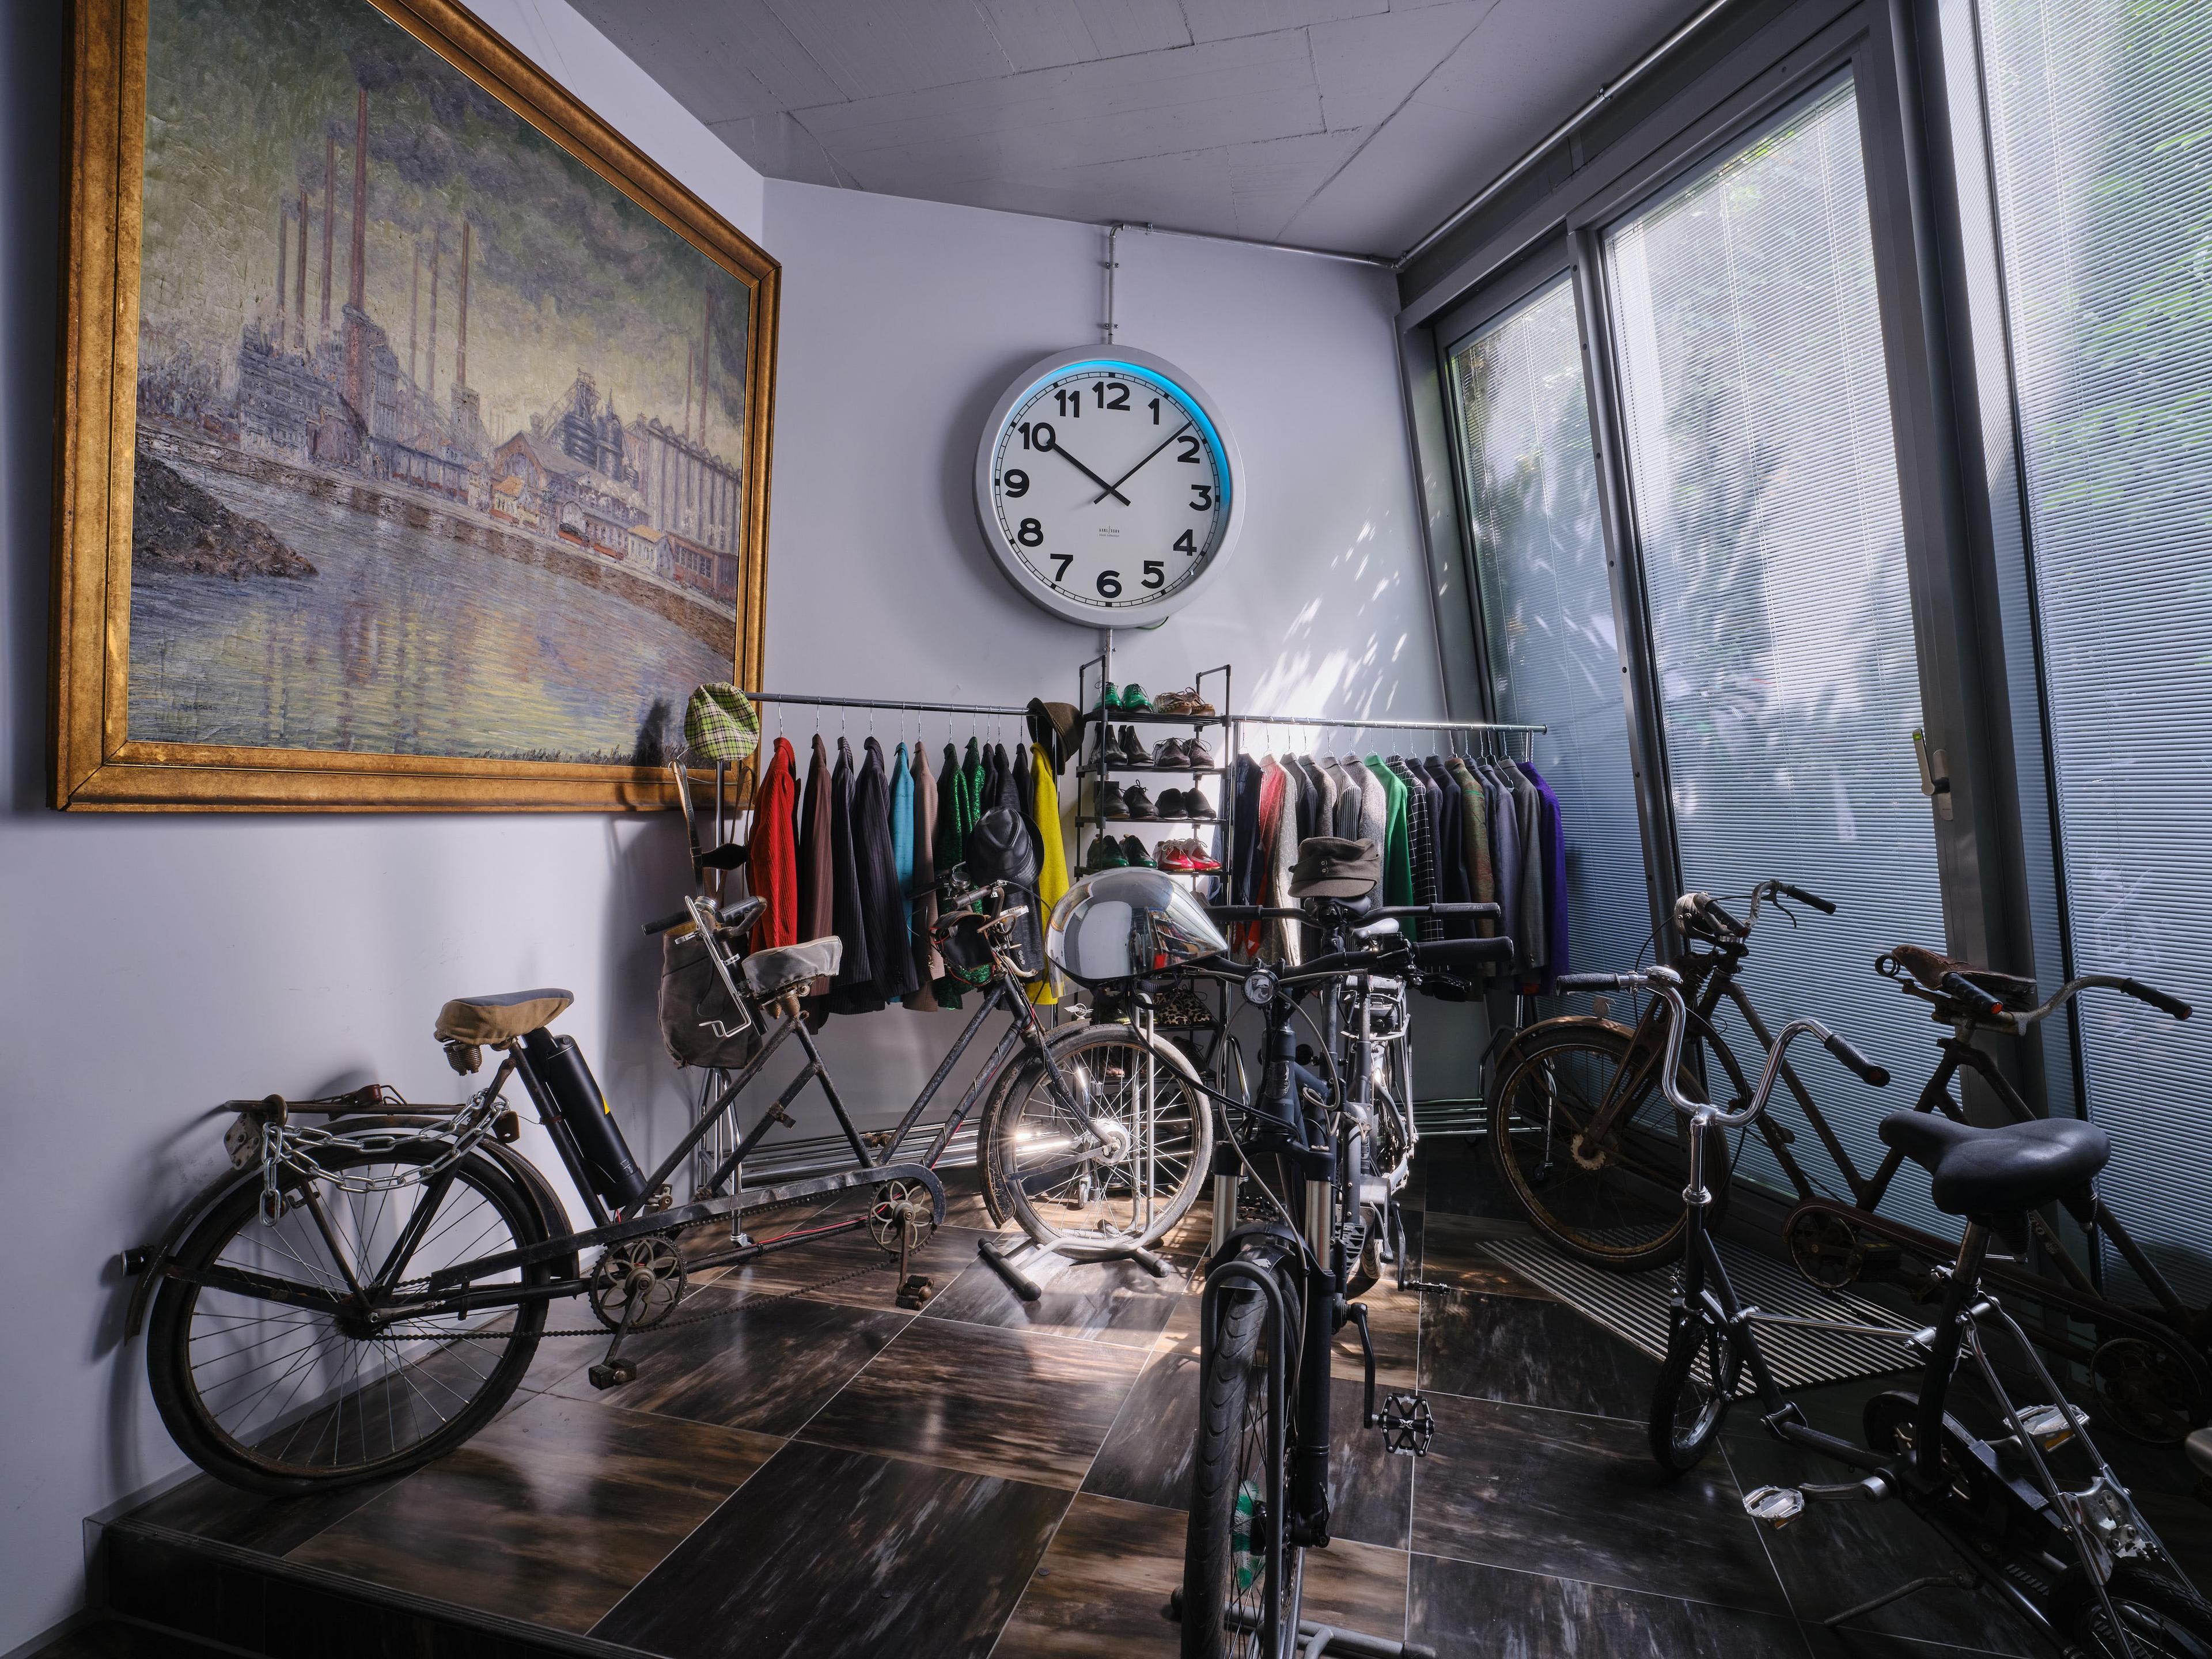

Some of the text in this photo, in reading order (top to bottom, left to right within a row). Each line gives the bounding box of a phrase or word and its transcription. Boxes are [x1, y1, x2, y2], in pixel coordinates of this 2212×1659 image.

[1054, 389, 1080, 418] 11
[1092, 381, 1130, 411] 12
[1148, 398, 1160, 425] 1
[1018, 422, 1056, 452] 10
[1177, 435, 1200, 464] 2
[1004, 469, 1030, 498] 9
[1189, 484, 1213, 511] 3
[1018, 518, 1044, 547] 8
[1173, 529, 1197, 556] 4
[1050, 554, 1074, 581] 7
[1141, 560, 1165, 589] 5
[1097, 570, 1122, 598] 6
